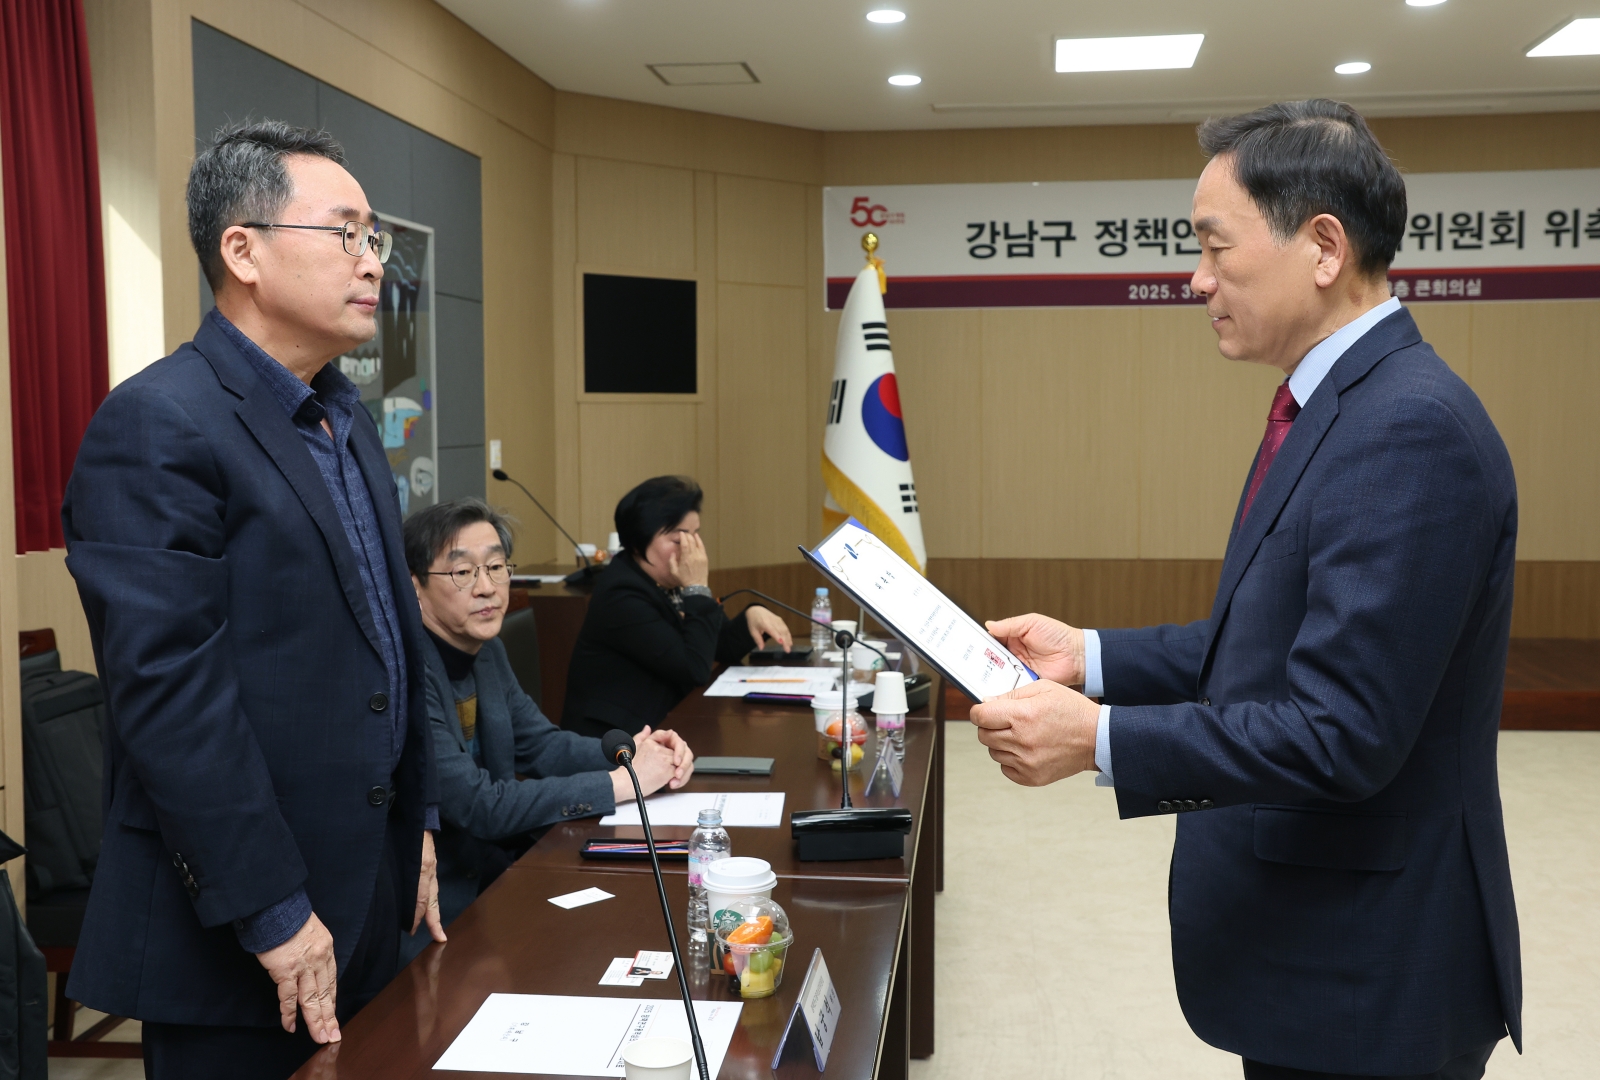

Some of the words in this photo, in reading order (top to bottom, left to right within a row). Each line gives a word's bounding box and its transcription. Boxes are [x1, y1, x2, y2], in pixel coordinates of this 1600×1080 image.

[966, 218, 1077, 259] 강남구
[1397, 210, 1525, 251] 위원회
[1128, 284, 1176, 300] 2025.
[1414, 278, 1482, 298] 큰회의실
